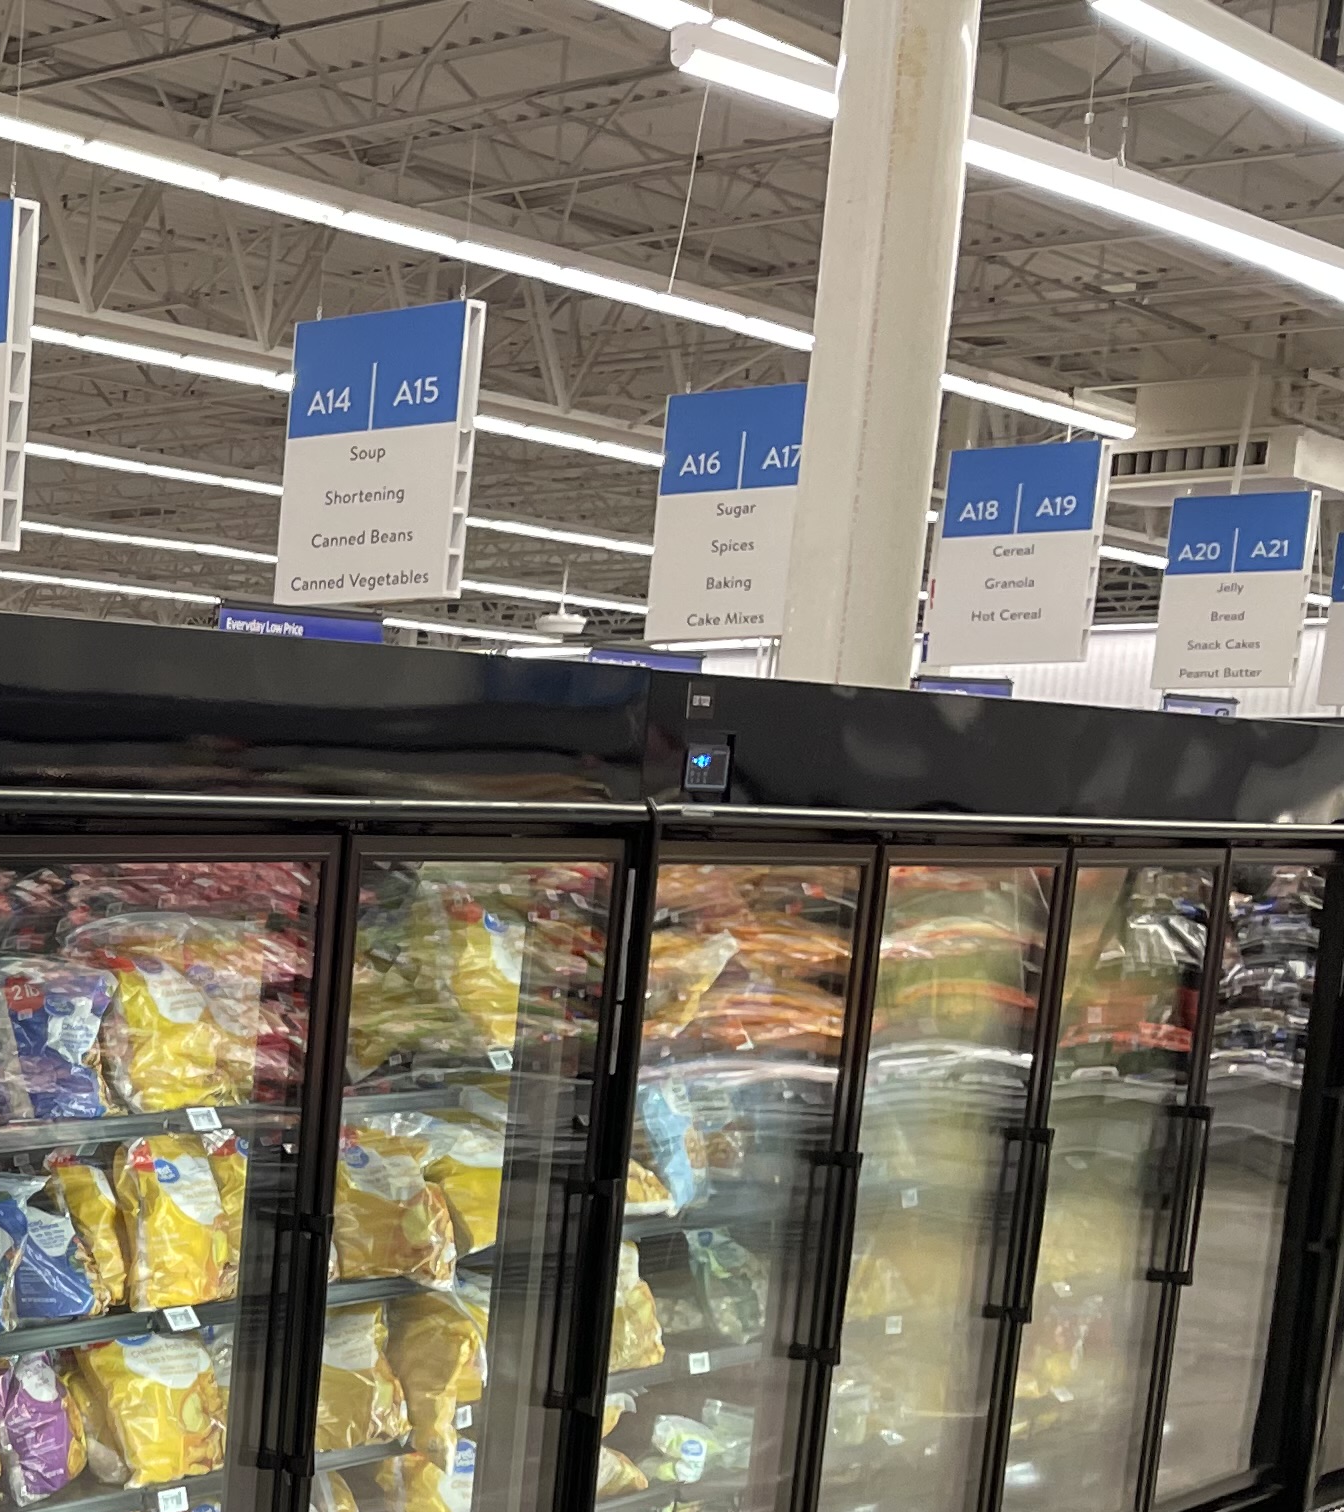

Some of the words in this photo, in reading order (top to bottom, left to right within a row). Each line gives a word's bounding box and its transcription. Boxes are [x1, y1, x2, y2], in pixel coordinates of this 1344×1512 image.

[307, 386, 351, 417] A14
[392, 376, 439, 407] A15
[350, 445, 386, 463] Soup
[679, 451, 722, 477] A16
[761, 444, 803, 470] A17
[324, 486, 405, 506] Shortening
[716, 502, 757, 519] Sugar
[959, 500, 999, 522] A18
[1035, 495, 1077, 517] A19
[311, 530, 366, 549] Canned
[370, 529, 414, 545] Beans
[711, 539, 755, 556] Spices
[992, 544, 1035, 557] Cereal
[1178, 542, 1221, 562] A20
[1250, 539, 1289, 558] A21
[290, 573, 345, 592] Canned
[350, 569, 429, 591] Vegetables
[706, 576, 752, 591] Baking
[984, 577, 1035, 590] Granola
[1216, 582, 1245, 595] Jelly
[686, 613, 721, 627] Cake
[724, 611, 765, 625] Mixes
[971, 610, 996, 622] Hot
[999, 608, 1042, 621] Cereal
[1210, 611, 1245, 622] Bread
[226, 616, 266, 634] Everyday
[266, 620, 283, 635] Low
[283, 621, 305, 637] Price
[1187, 640, 1221, 651] Snack
[1225, 639, 1261, 650] Cakes
[1178, 668, 1220, 679] Peanut
[1223, 667, 1262, 678] Butter
